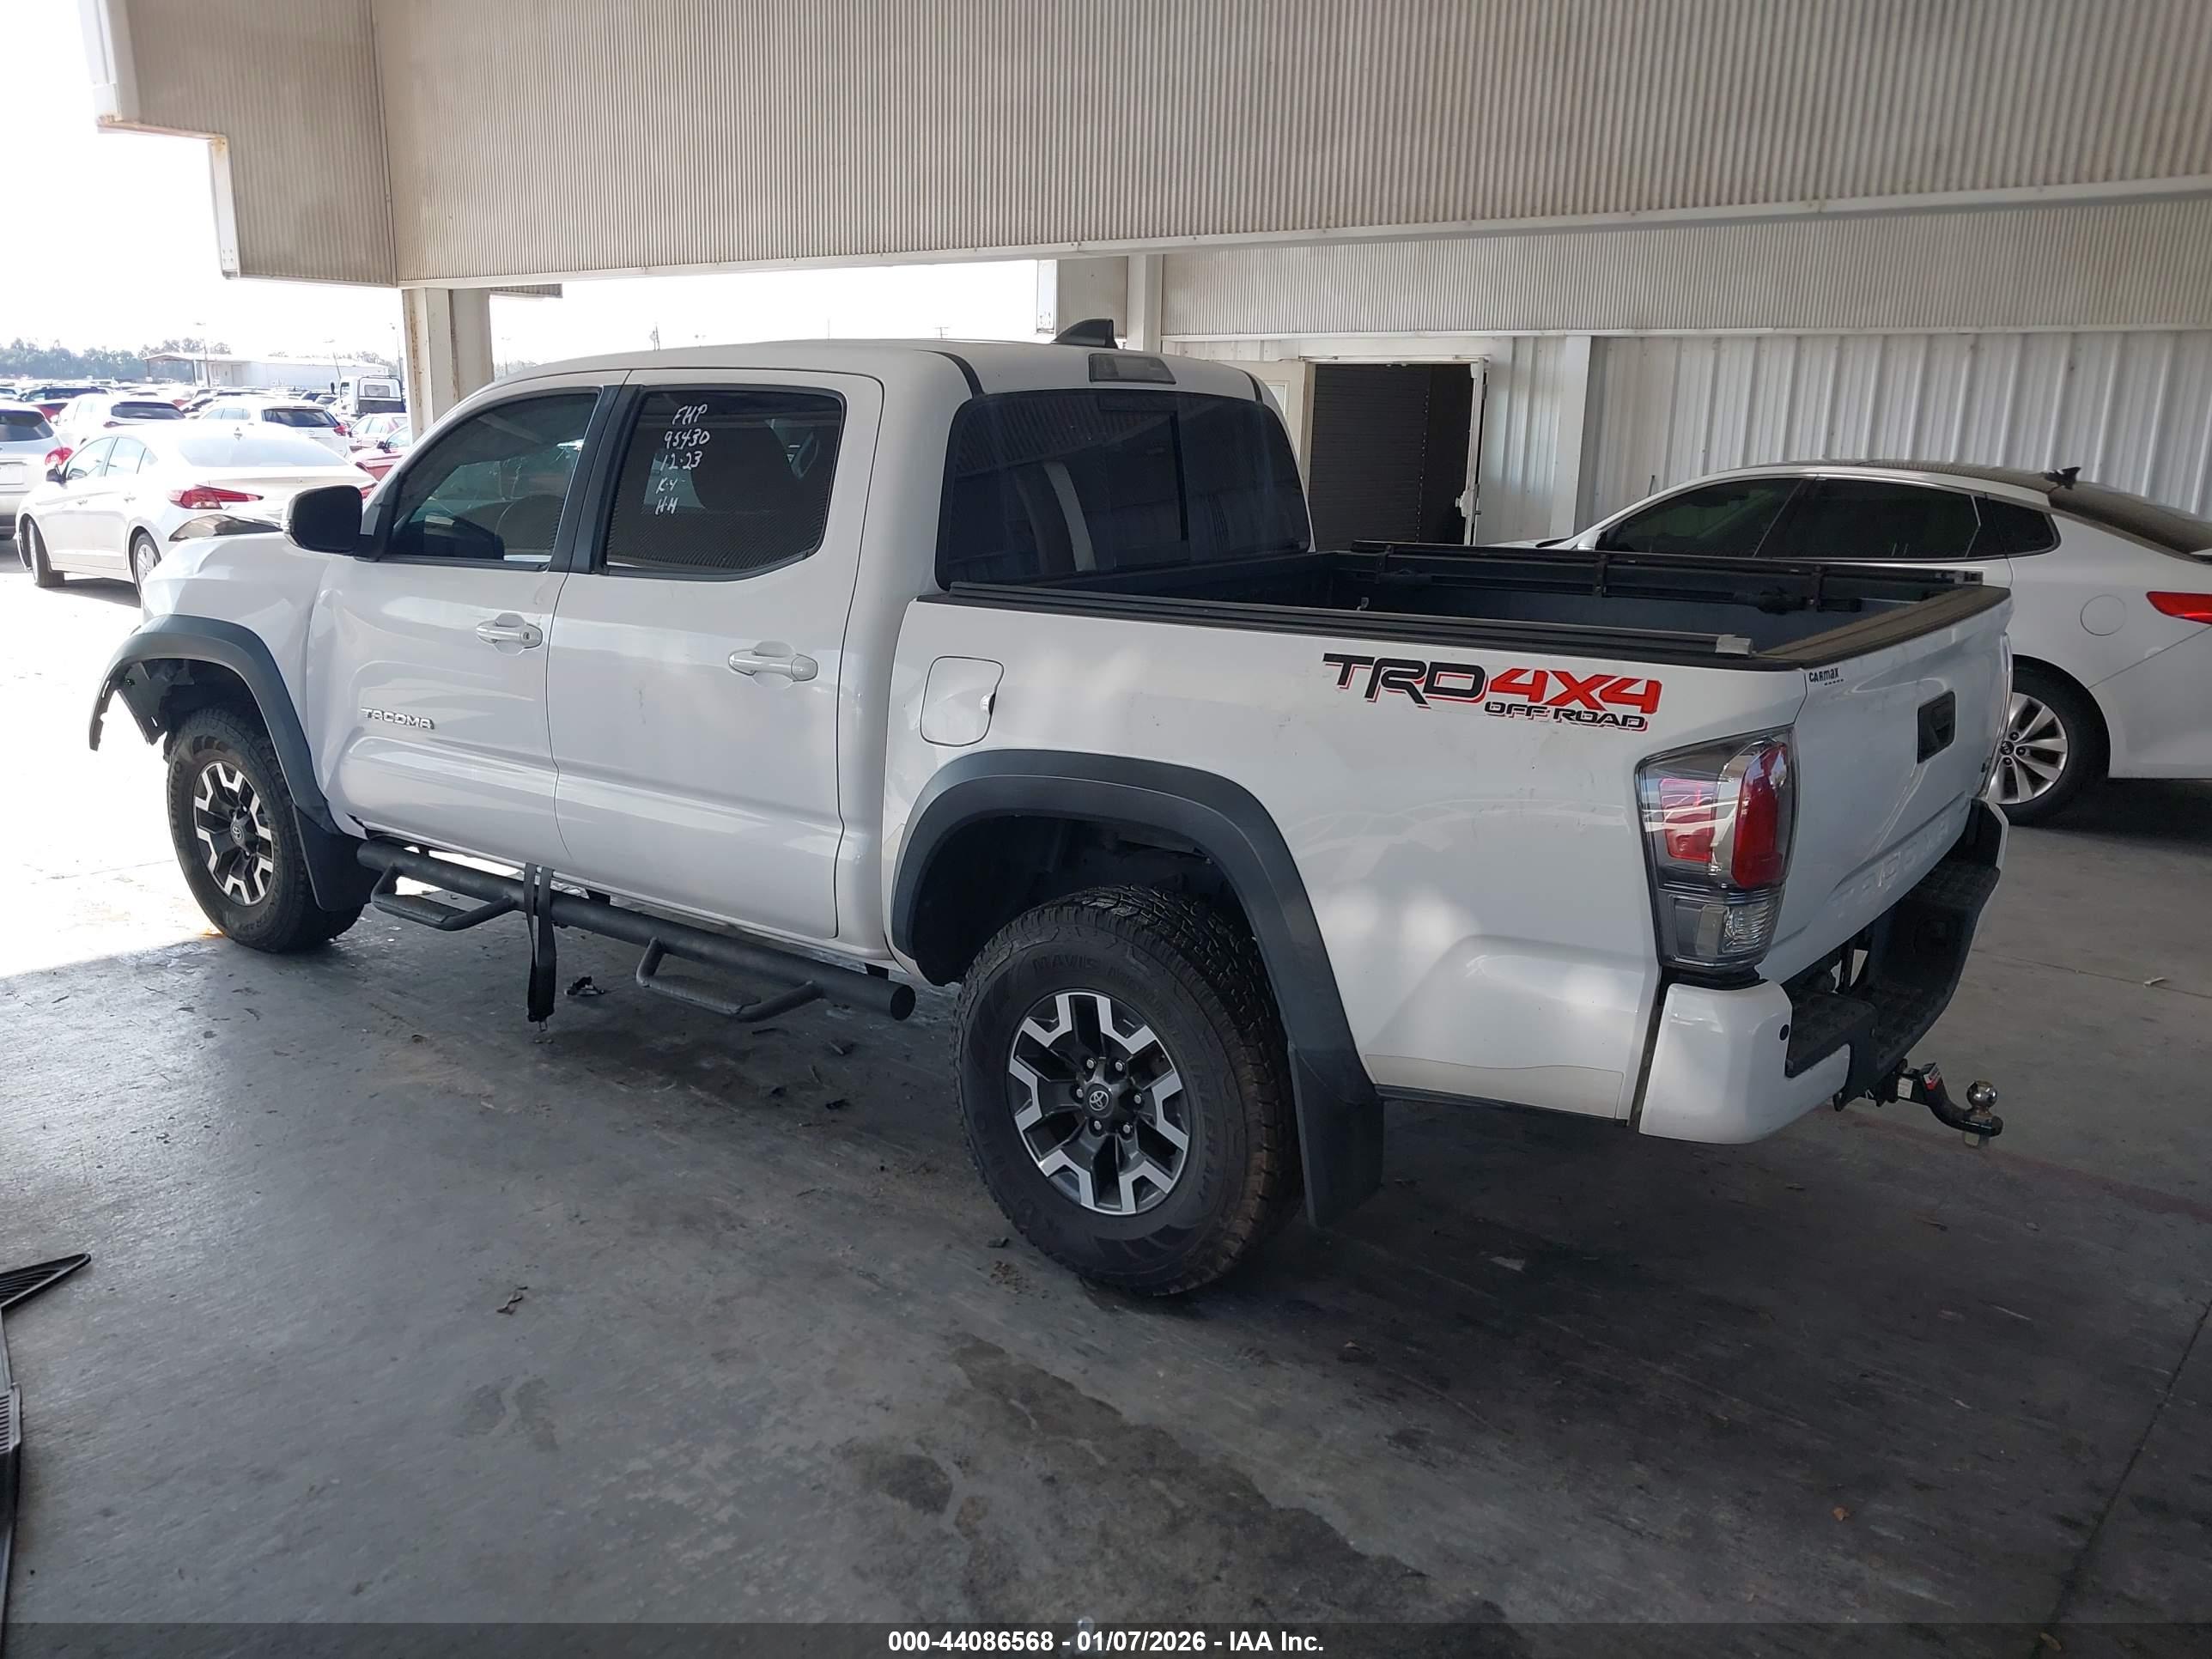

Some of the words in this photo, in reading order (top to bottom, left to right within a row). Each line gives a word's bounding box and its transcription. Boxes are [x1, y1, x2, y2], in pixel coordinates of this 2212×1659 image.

[672, 404, 708, 425] FHP
[1323, 653, 1486, 708] TRD
[1489, 668, 1663, 714] 4X4
[361, 707, 435, 730] TACOMA
[1484, 700, 1551, 720] OFF
[1553, 708, 1649, 732] ROAD
